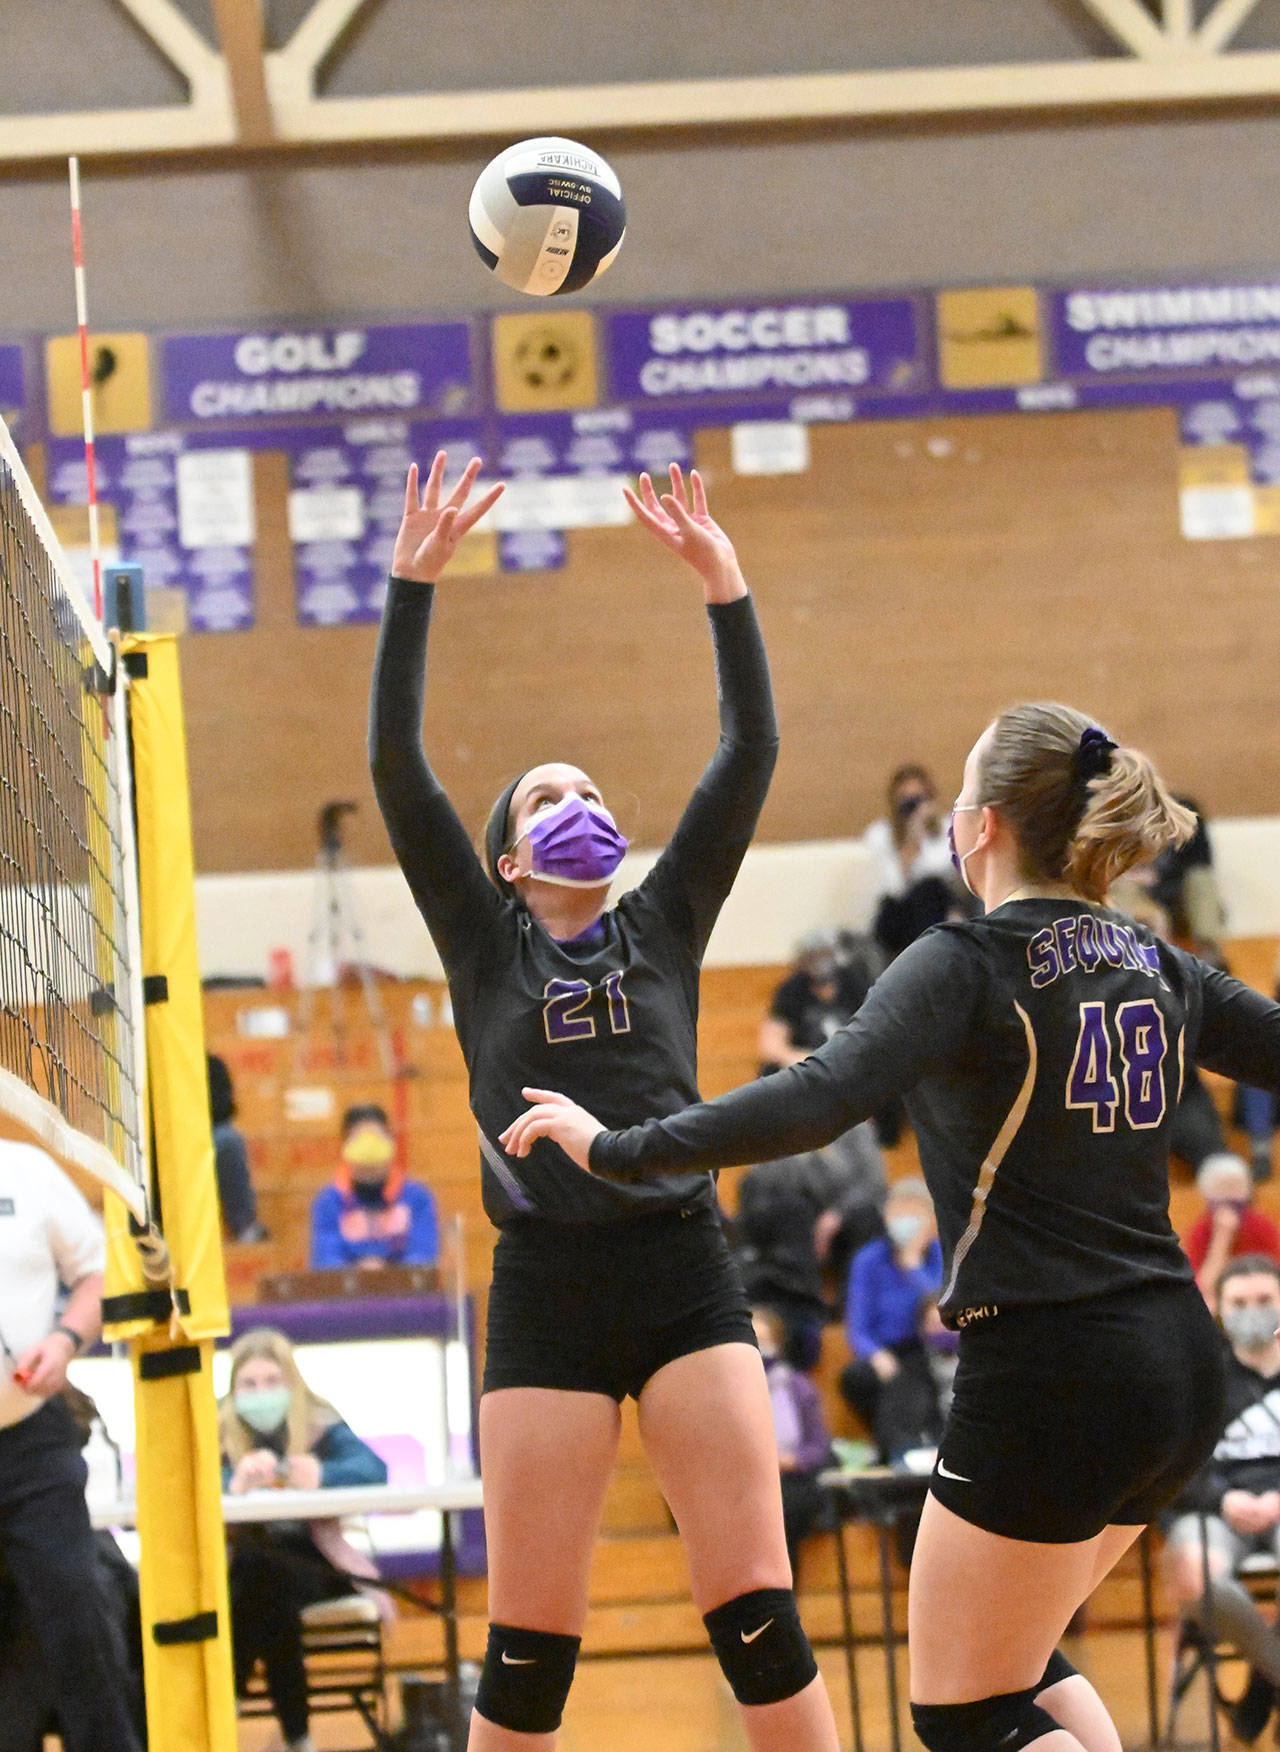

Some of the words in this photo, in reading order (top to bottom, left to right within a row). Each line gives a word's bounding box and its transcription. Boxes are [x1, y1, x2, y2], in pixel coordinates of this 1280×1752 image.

[548, 187, 592, 205] OFFICIAL
[234, 330, 366, 375] GOLF
[650, 306, 849, 354] SOCCER
[190, 370, 420, 418] CHAMPIONS
[640, 348, 870, 396] CHAMPIONS
[543, 969, 631, 1044] 21
[1065, 999, 1168, 1133] 48
